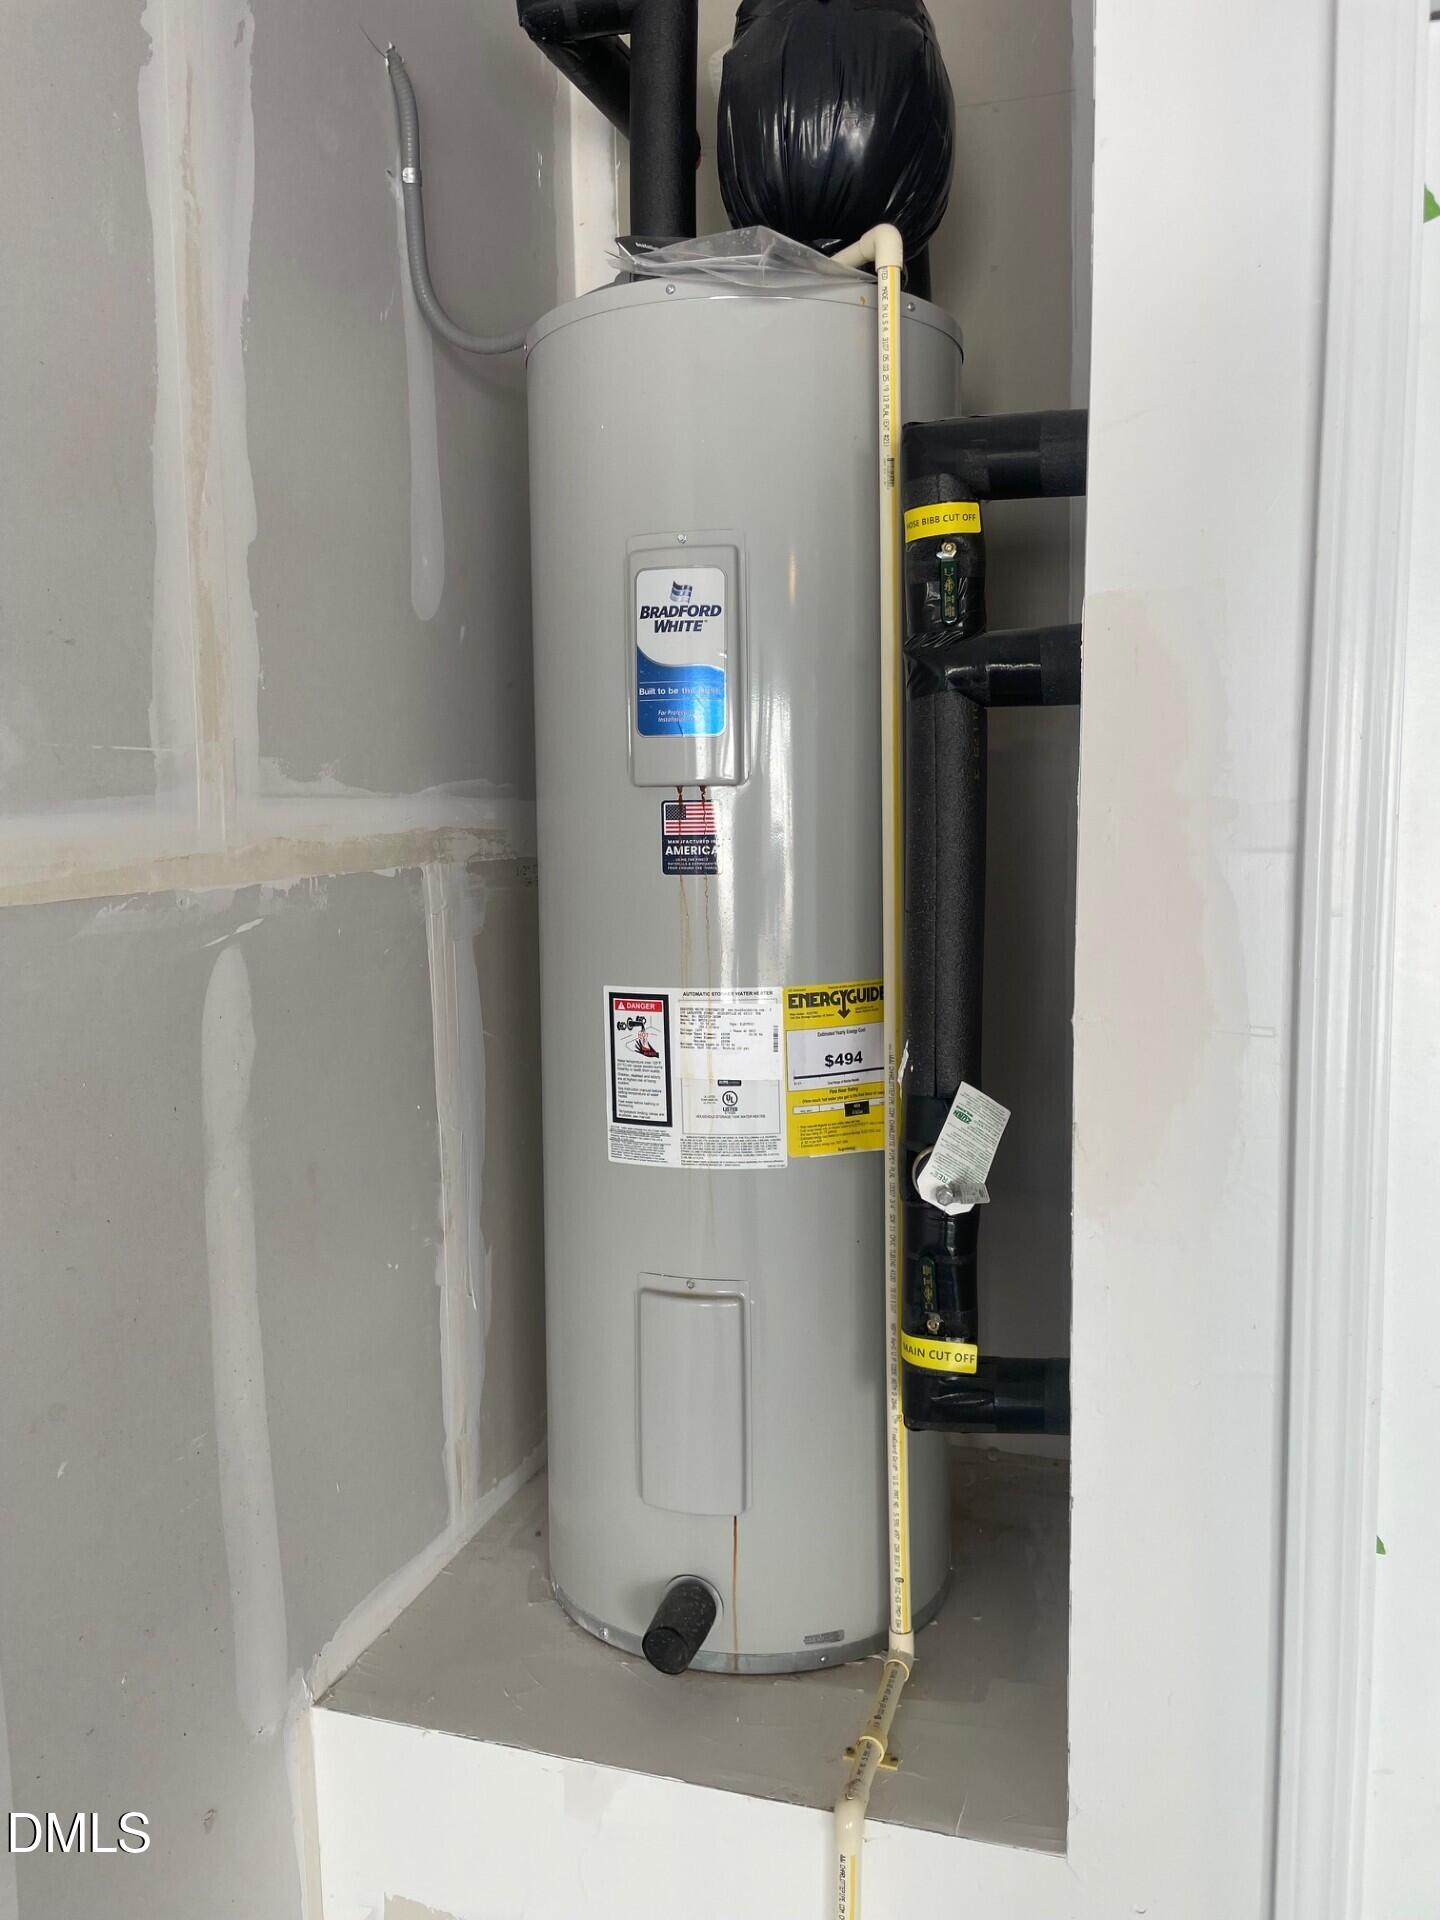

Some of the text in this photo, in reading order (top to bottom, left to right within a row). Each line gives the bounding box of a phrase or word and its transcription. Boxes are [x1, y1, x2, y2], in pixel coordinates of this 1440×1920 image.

[921, 515, 941, 526] BIBB
[942, 513, 961, 522] CUT
[962, 513, 977, 521] OFF
[639, 604, 722, 619] BRADFORD
[654, 619, 703, 633] WHITE
[639, 687, 656, 696] Built
[657, 687, 666, 695] to
[665, 845, 719, 856] AMERICA
[626, 1001, 656, 1010] DANGER
[824, 1050, 864, 1069] $494
[902, 1342, 976, 1364] MAIN CUT OFF
